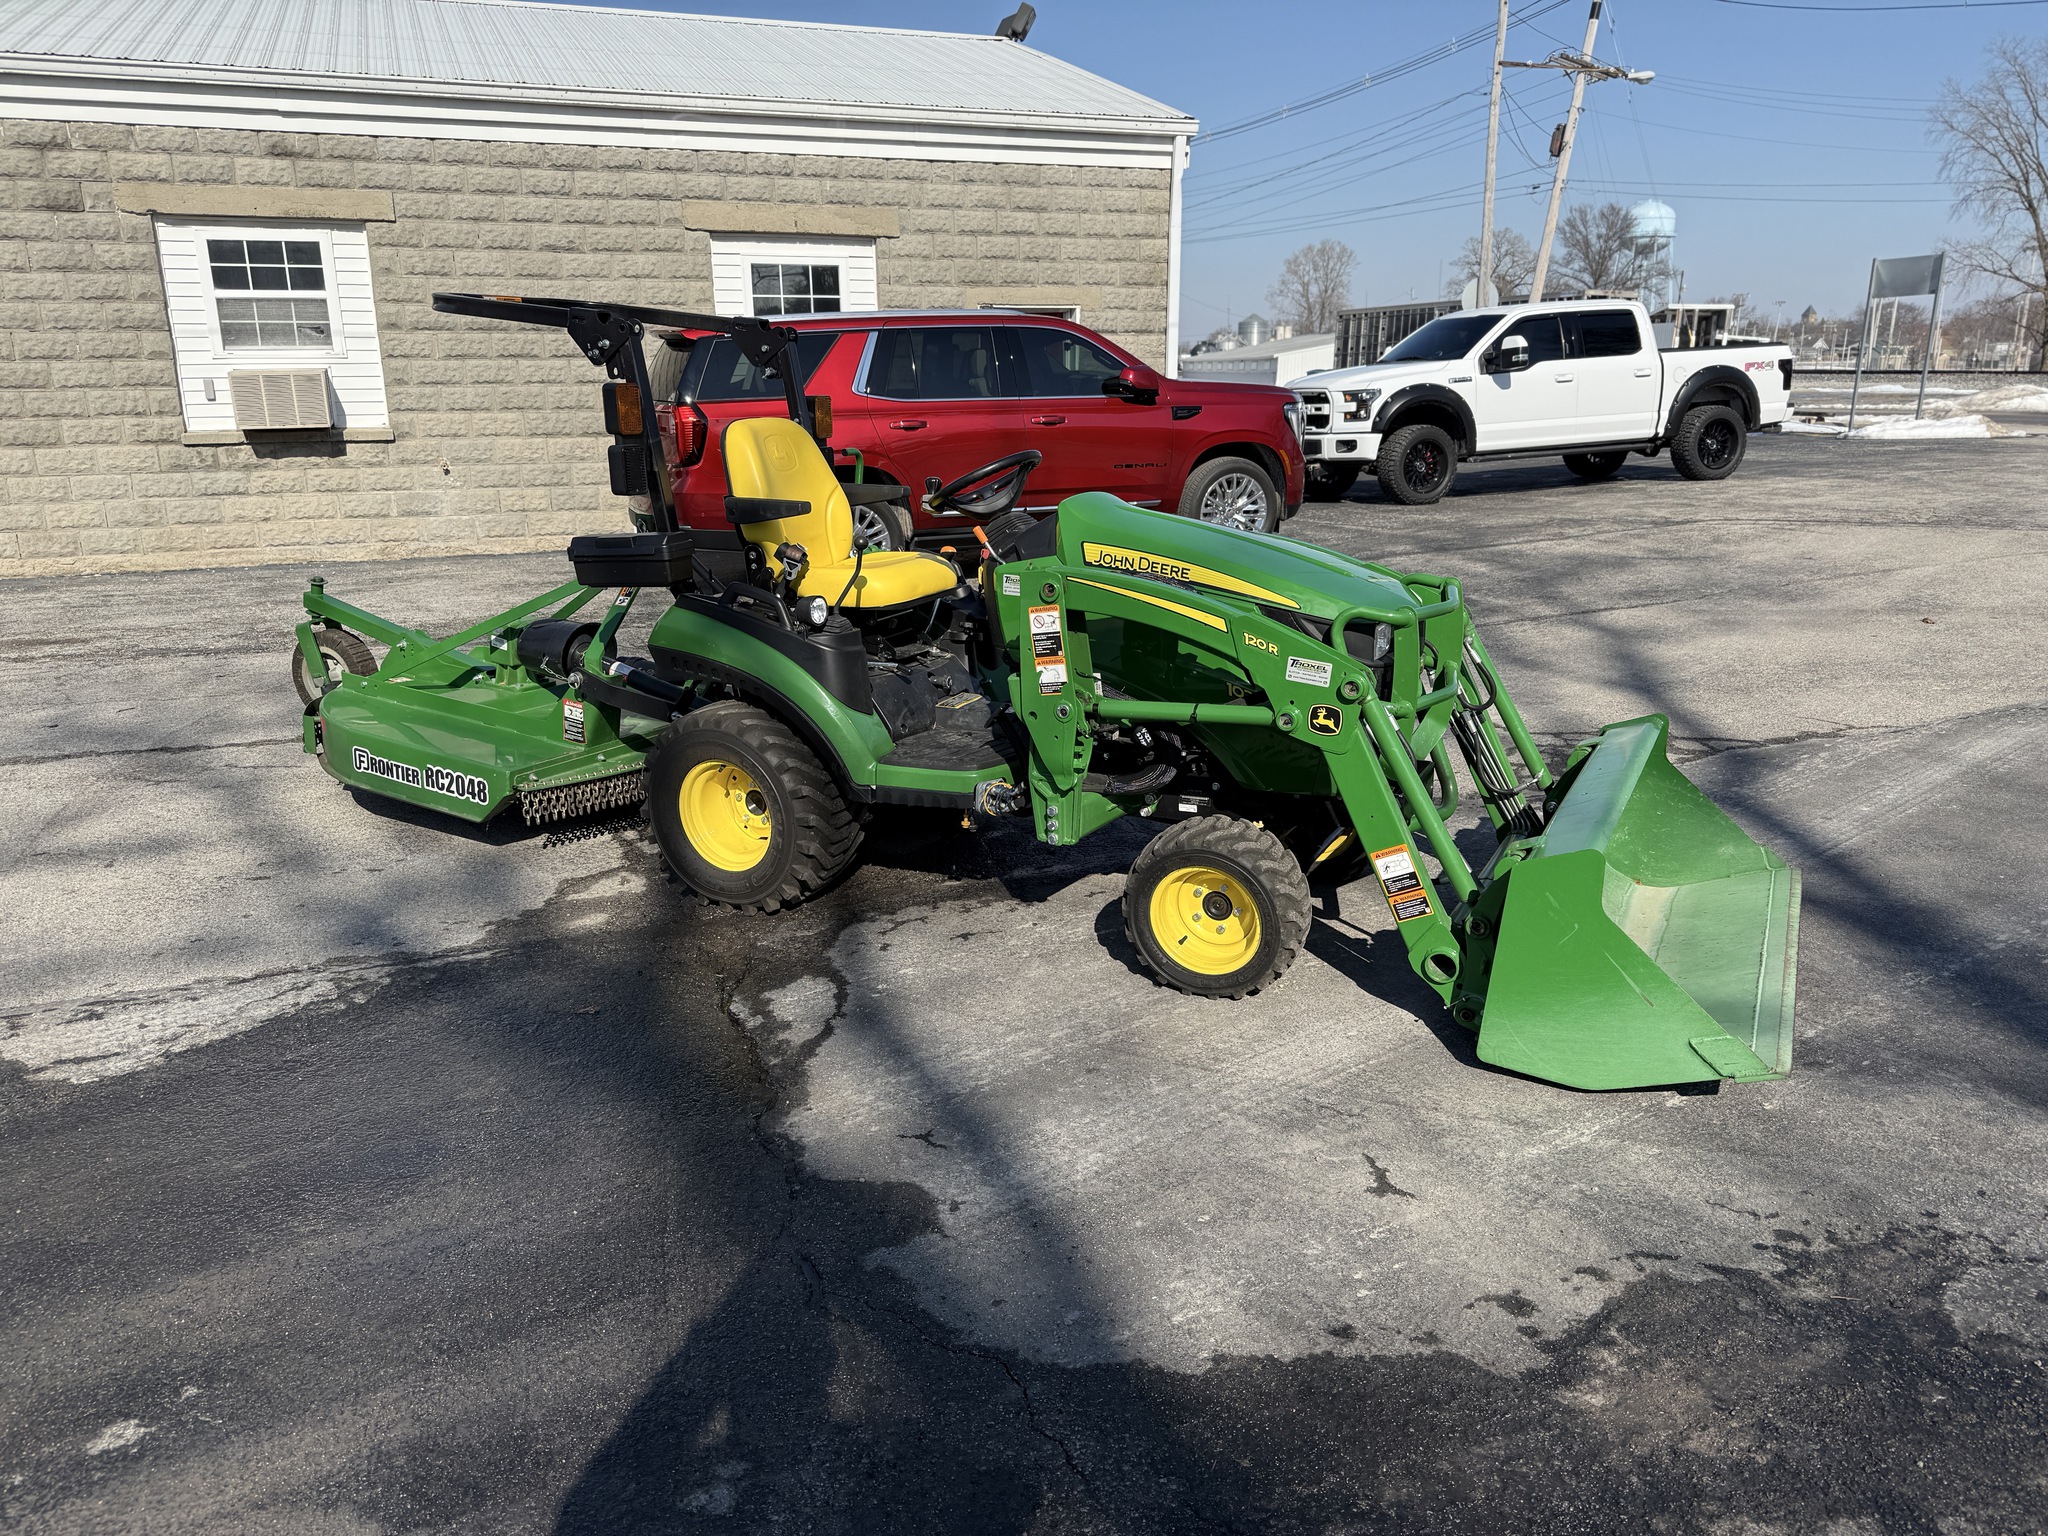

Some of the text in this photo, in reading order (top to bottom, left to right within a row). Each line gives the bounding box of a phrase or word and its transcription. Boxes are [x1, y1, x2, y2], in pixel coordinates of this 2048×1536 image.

[1744, 360, 1774, 372] FX4
[1093, 549, 1191, 580] JOHN DEERE
[1243, 632, 1279, 656] 120 R
[1290, 658, 1328, 671] TROXEL
[353, 747, 488, 804] FRONTIER RC2048
[1381, 847, 1404, 857] WARNING
[1399, 892, 1423, 902] WARNING
